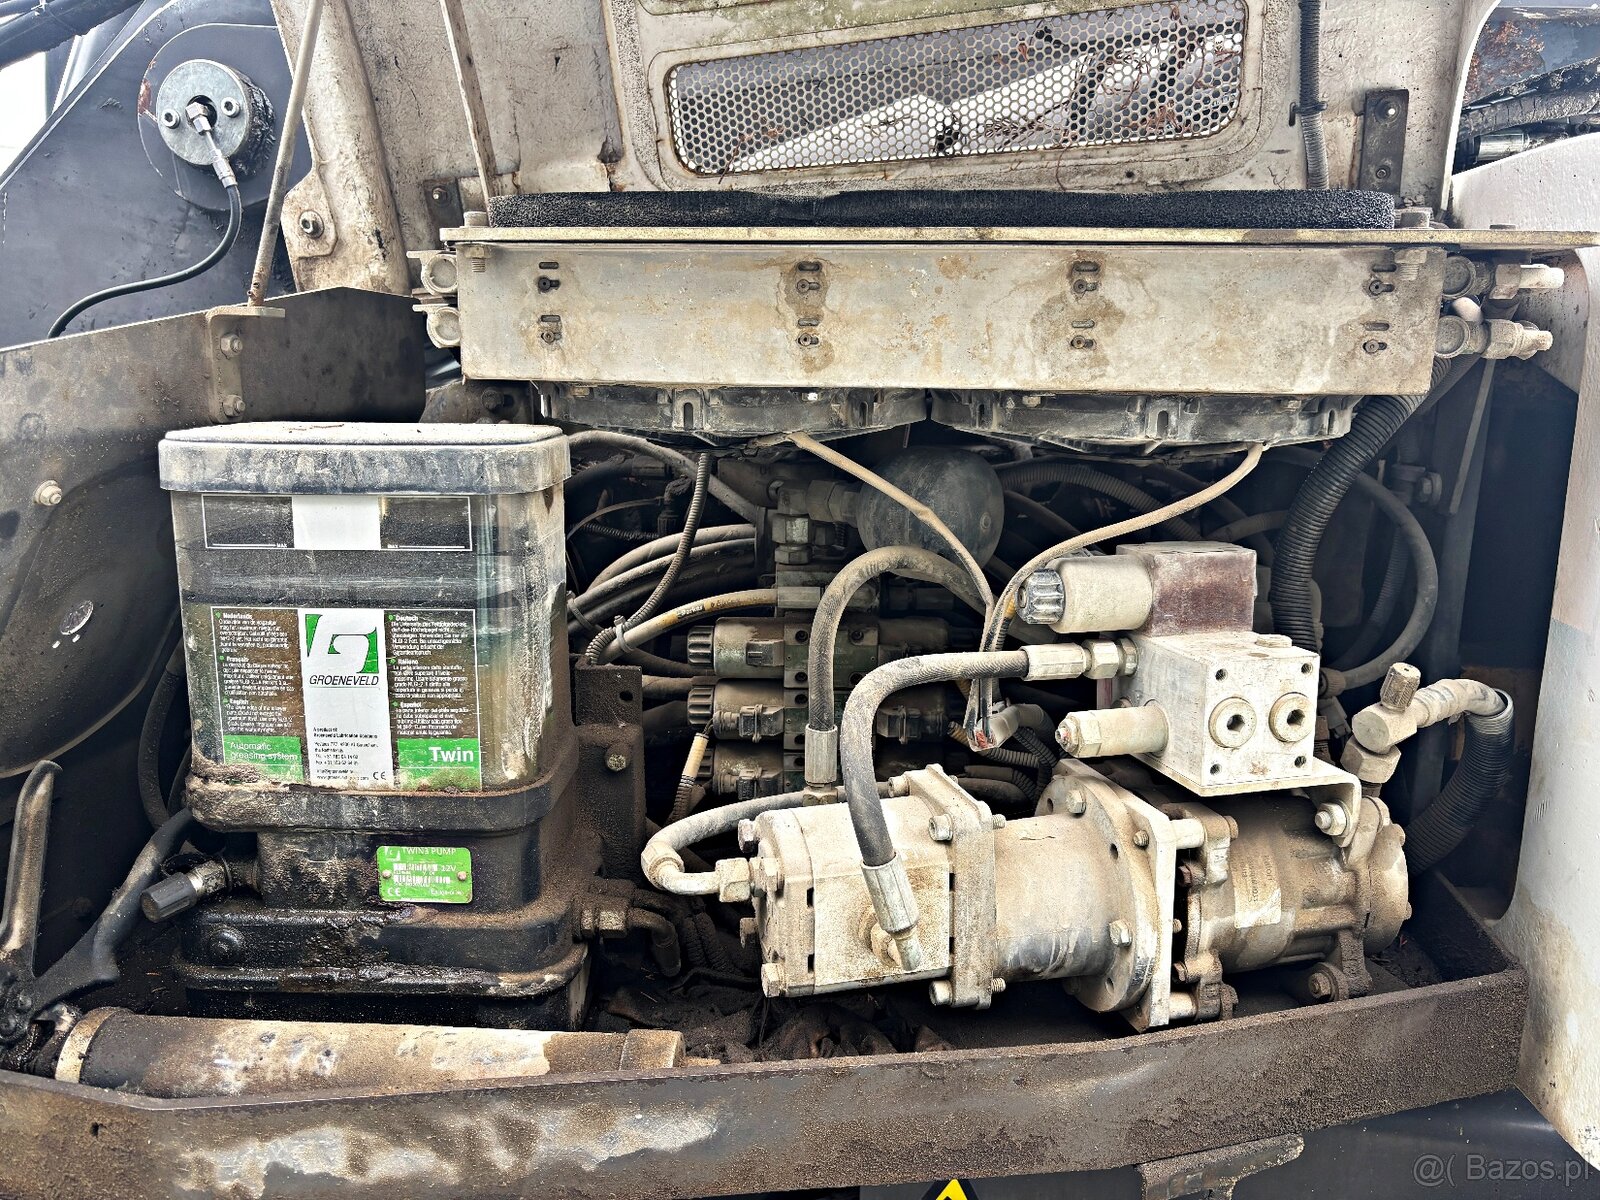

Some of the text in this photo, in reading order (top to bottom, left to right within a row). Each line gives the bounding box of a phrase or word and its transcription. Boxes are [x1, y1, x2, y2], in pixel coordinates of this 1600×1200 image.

[309, 674, 379, 686] GROENEVELD
[230, 742, 272, 750] Automatic
[428, 746, 474, 762] Twin
[431, 847, 457, 855] PUMP
